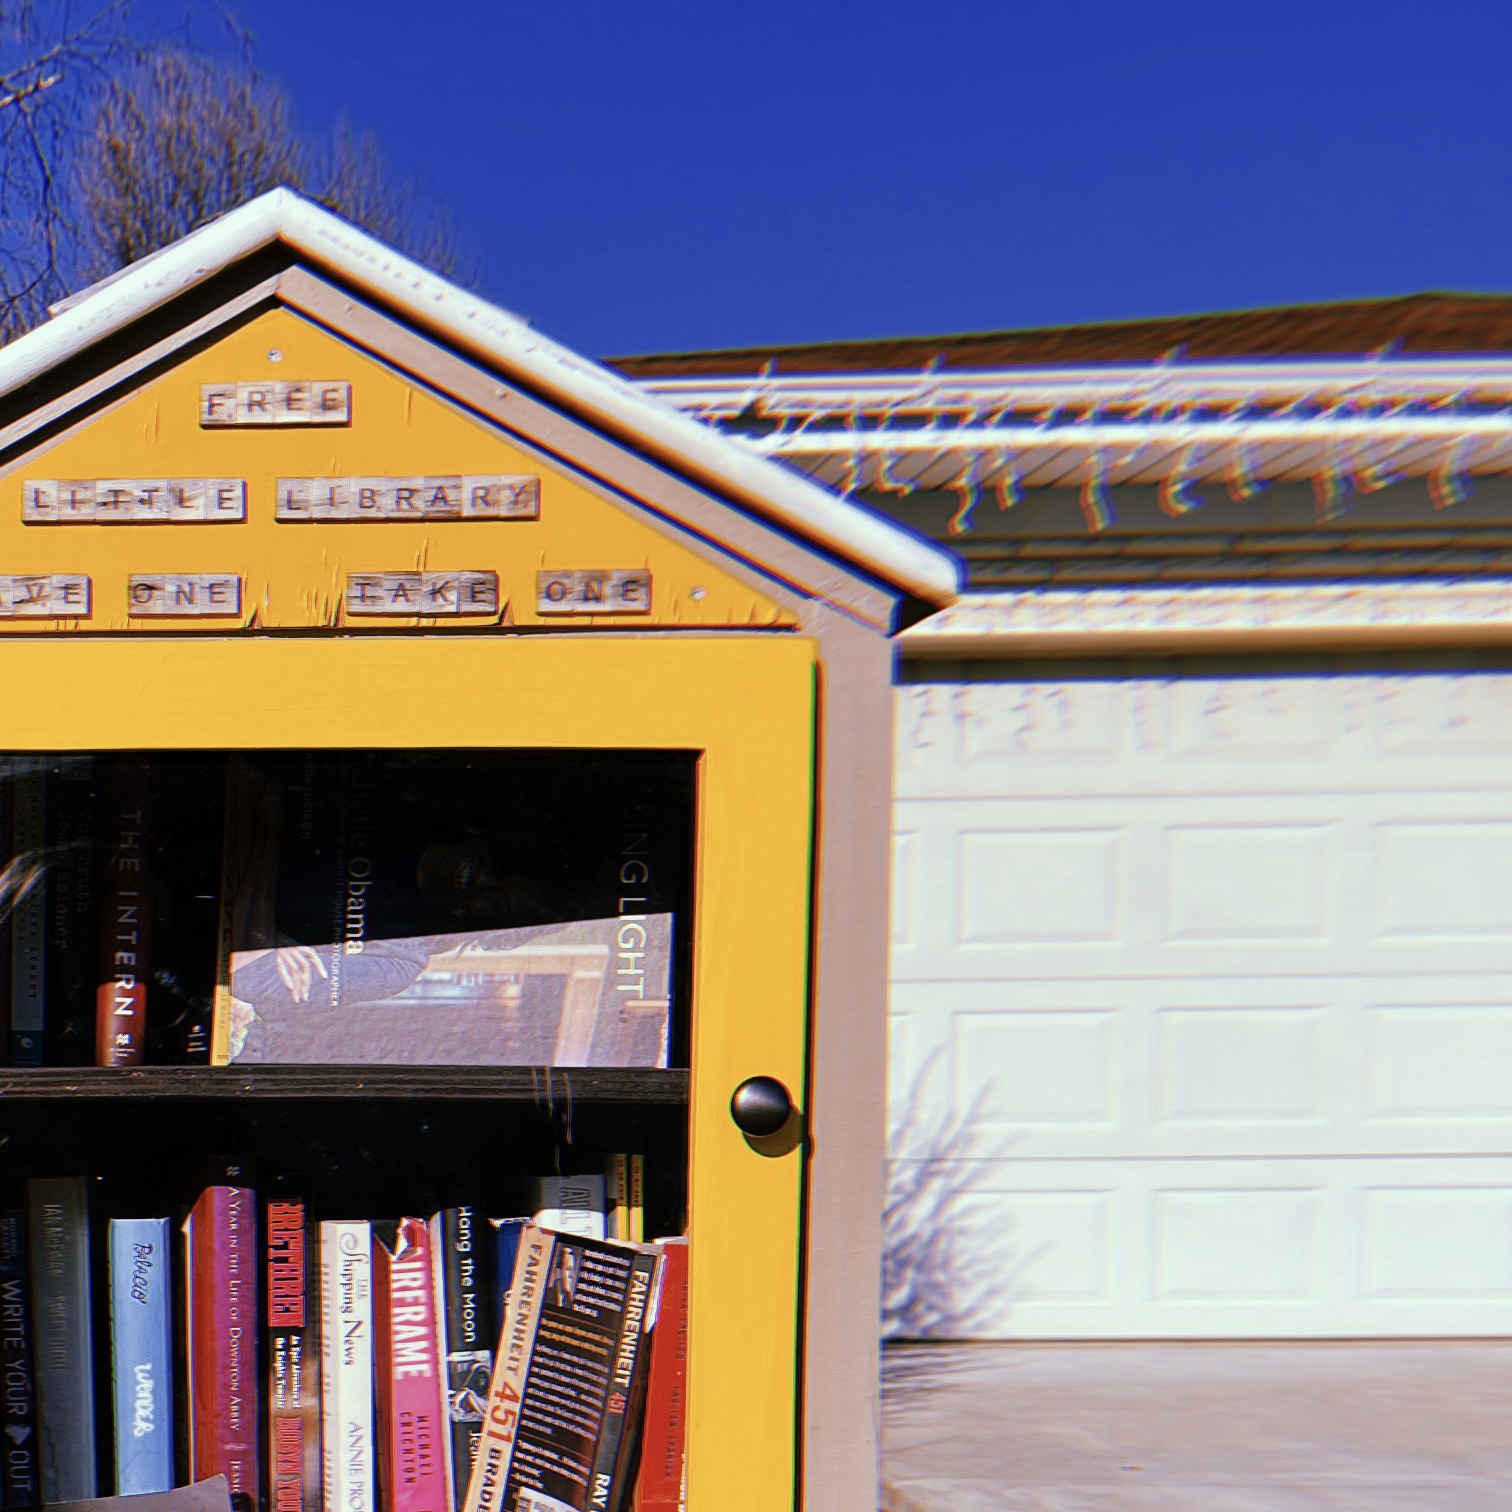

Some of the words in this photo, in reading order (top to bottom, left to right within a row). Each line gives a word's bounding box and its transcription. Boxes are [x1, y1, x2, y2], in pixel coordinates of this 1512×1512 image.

[207, 387, 341, 418] FREE
[32, 484, 238, 514] LITTLE
[285, 482, 530, 514] LIBRARY
[131, 578, 228, 607] ONE
[352, 577, 489, 605] TAKE
[544, 578, 644, 603] ONE
[117, 808, 145, 873] THE
[343, 857, 374, 956] Obama
[112, 890, 140, 1017] INTERN
[329, 927, 342, 1007] PHOTOGRAPHER
[615, 897, 648, 1000] LIGHT
[227, 1187, 241, 1198] A
[227, 1200, 242, 1231] YEAR
[455, 1207, 476, 1252] Hang
[227, 1235, 240, 1248] IN
[227, 1252, 240, 1275] THE
[267, 1202, 307, 1329] BRETHREN
[338, 1232, 371, 1314] Shipping
[460, 1258, 477, 1288] the
[227, 1279, 242, 1303] LIFE
[356, 1278, 369, 1300] THE
[505, 1243, 544, 1378] FAHRENHEIT
[0, 1279, 26, 1350] WRITE
[228, 1306, 241, 1321] OF
[461, 1293, 478, 1343] Moon
[613, 1270, 649, 1388] FAHRENHEIT
[228, 1327, 243, 1391] DOWNTON
[274, 1337, 286, 1349] the
[288, 1347, 303, 1363] Epic
[289, 1335, 302, 1345] An
[342, 1320, 365, 1366] News
[272, 1350, 287, 1377] Knights
[289, 1364, 303, 1399] Adventure
[3, 1358, 30, 1416] YOUR
[273, 1379, 287, 1410] Templar
[607, 1391, 627, 1416] 451
[228, 1396, 243, 1431] ABBEY
[485, 1381, 521, 1444] 451
[276, 1417, 305, 1475] ROBYN
[347, 1421, 365, 1477] ANNIE
[398, 1411, 418, 1485] CRICHTON
[415, 1414, 435, 1479] MICHAEL
[7, 1449, 33, 1493] OUT
[589, 1472, 611, 1509] RAY
